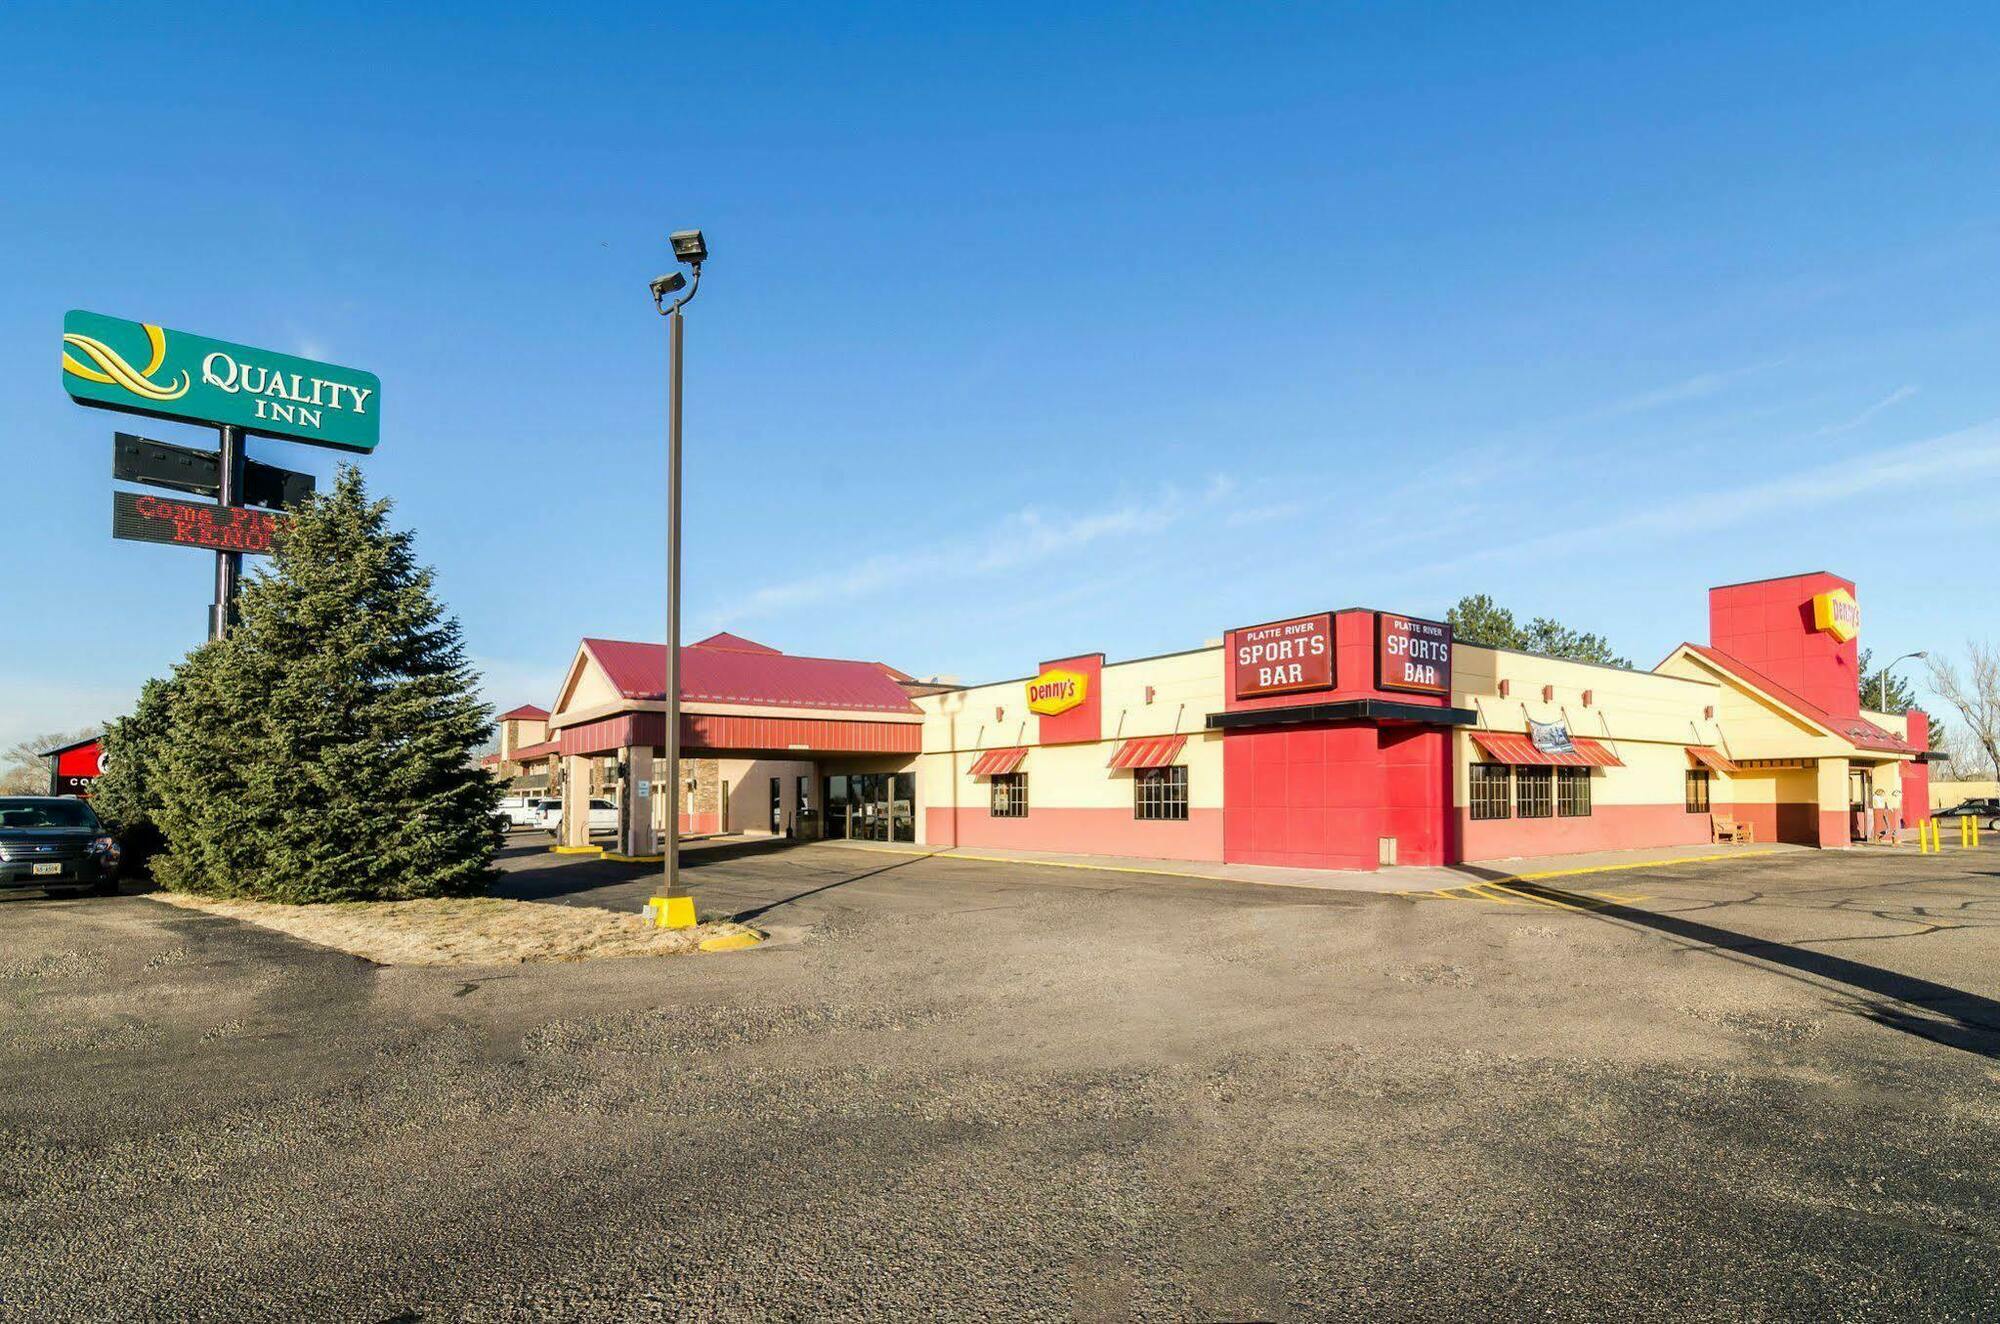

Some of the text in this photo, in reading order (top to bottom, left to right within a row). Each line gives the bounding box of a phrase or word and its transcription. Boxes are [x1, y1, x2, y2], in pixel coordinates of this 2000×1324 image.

[202, 352, 373, 414] QUALITY
[254, 399, 323, 429] INN
[135, 495, 297, 532] Come Pla
[1247, 622, 1314, 642] PLATTE RIVER
[1394, 620, 1442, 637] PLATTE RIVER
[1239, 635, 1325, 666] SPORTS
[1387, 635, 1448, 663] SPORTS
[1258, 663, 1303, 687] BAR
[1403, 661, 1435, 685] BAR
[1030, 678, 1076, 703] Denny's
